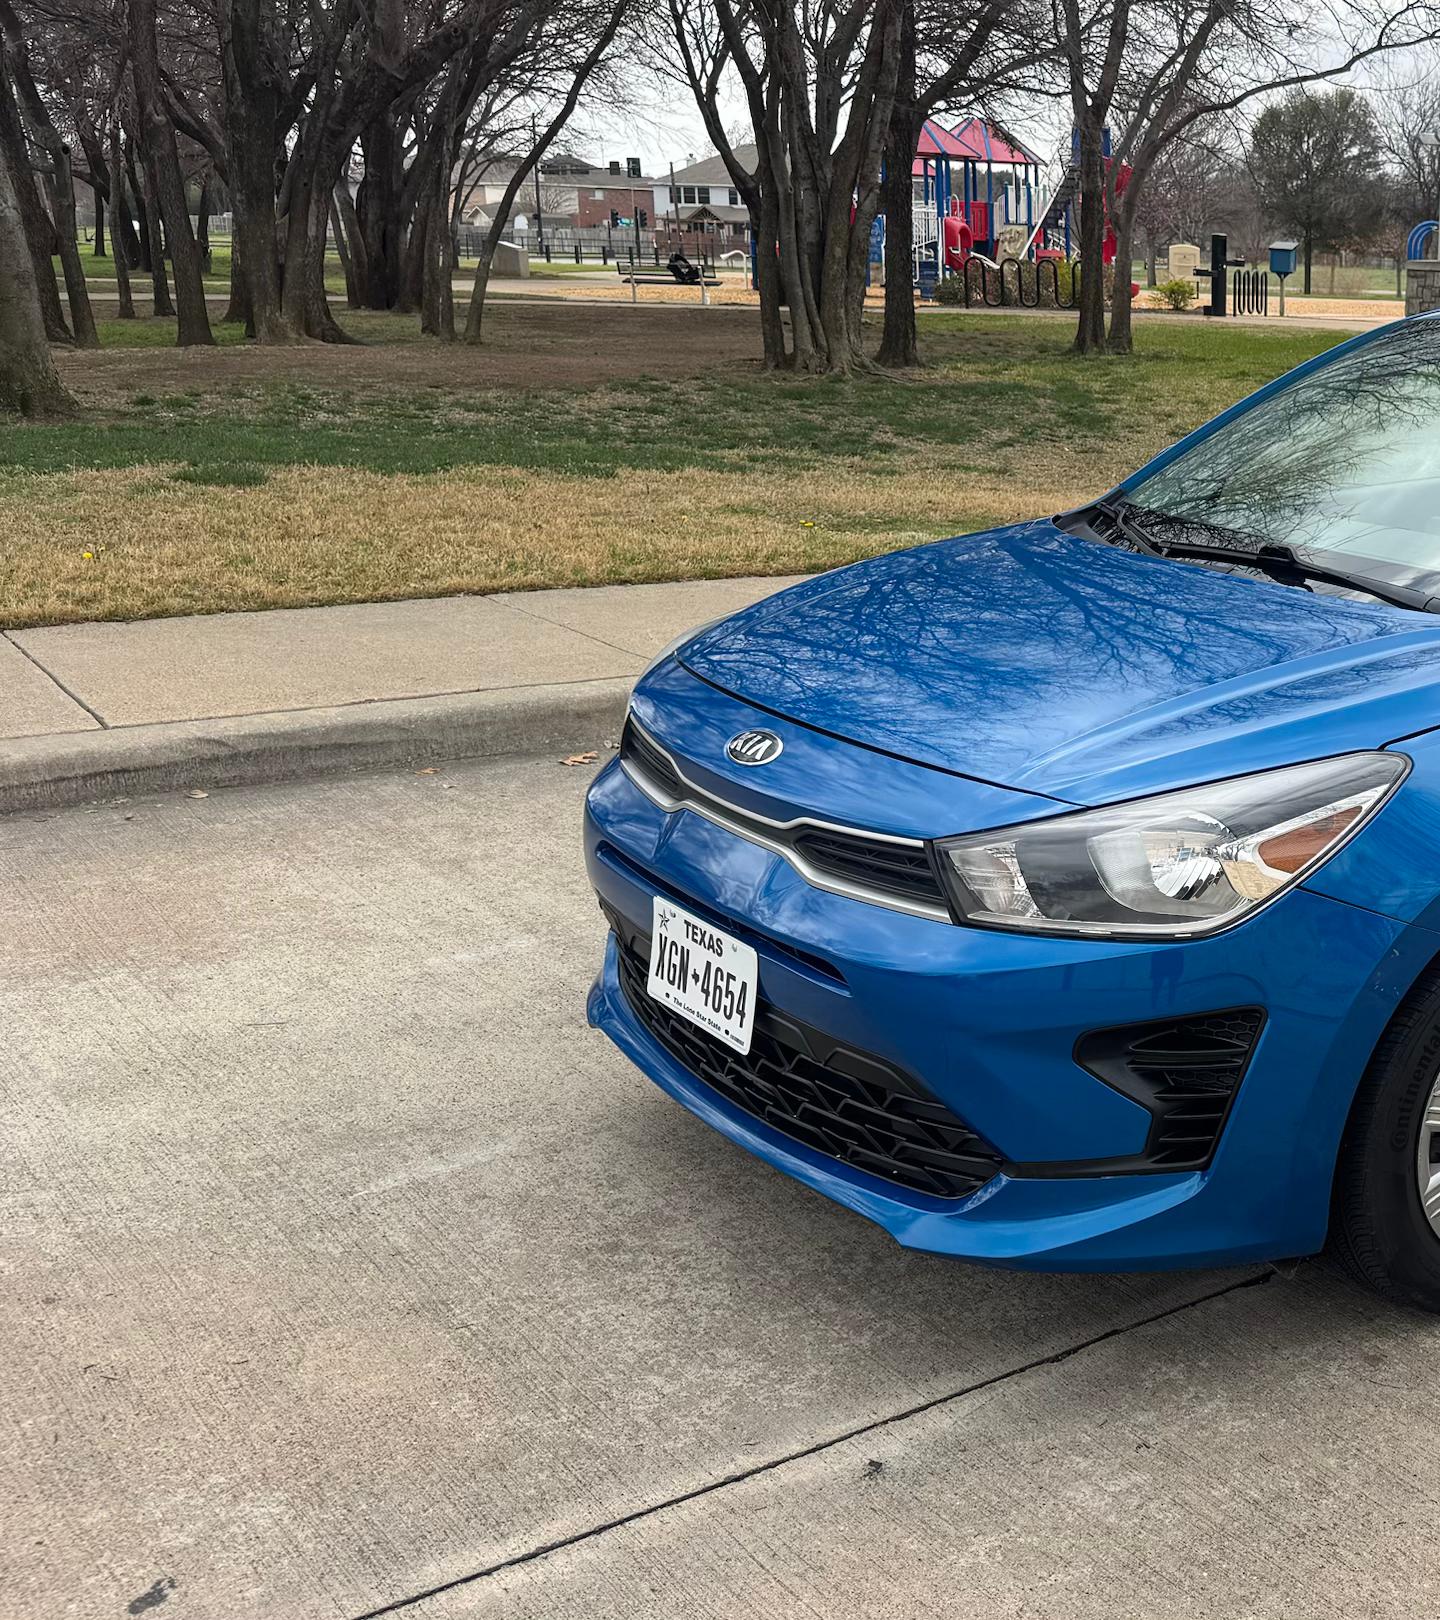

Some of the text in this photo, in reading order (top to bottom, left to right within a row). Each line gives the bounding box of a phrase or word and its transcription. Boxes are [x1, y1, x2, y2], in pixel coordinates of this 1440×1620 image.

[730, 732, 773, 760] KIA
[684, 919, 723, 957] TEXAS
[655, 933, 747, 1028] XGN 4654
[673, 997, 721, 1031] The Lone Star State
